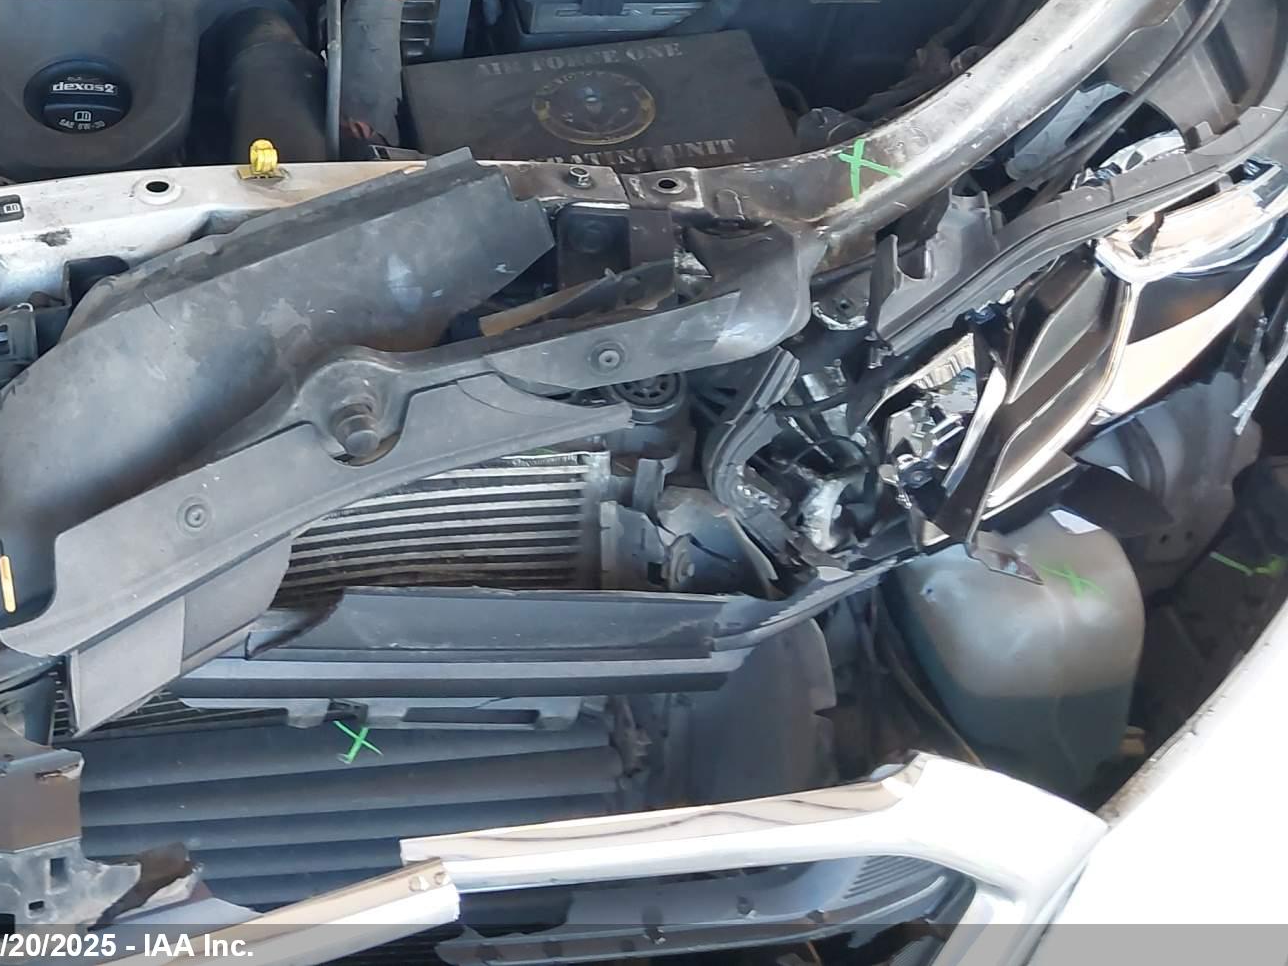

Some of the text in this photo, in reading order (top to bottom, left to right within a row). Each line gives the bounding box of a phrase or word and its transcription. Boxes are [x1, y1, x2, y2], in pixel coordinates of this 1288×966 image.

[530, 49, 619, 72] FORCE
[625, 43, 683, 61] ONE
[52, 81, 115, 93] dexos2
[661, 138, 736, 162] UNIT
